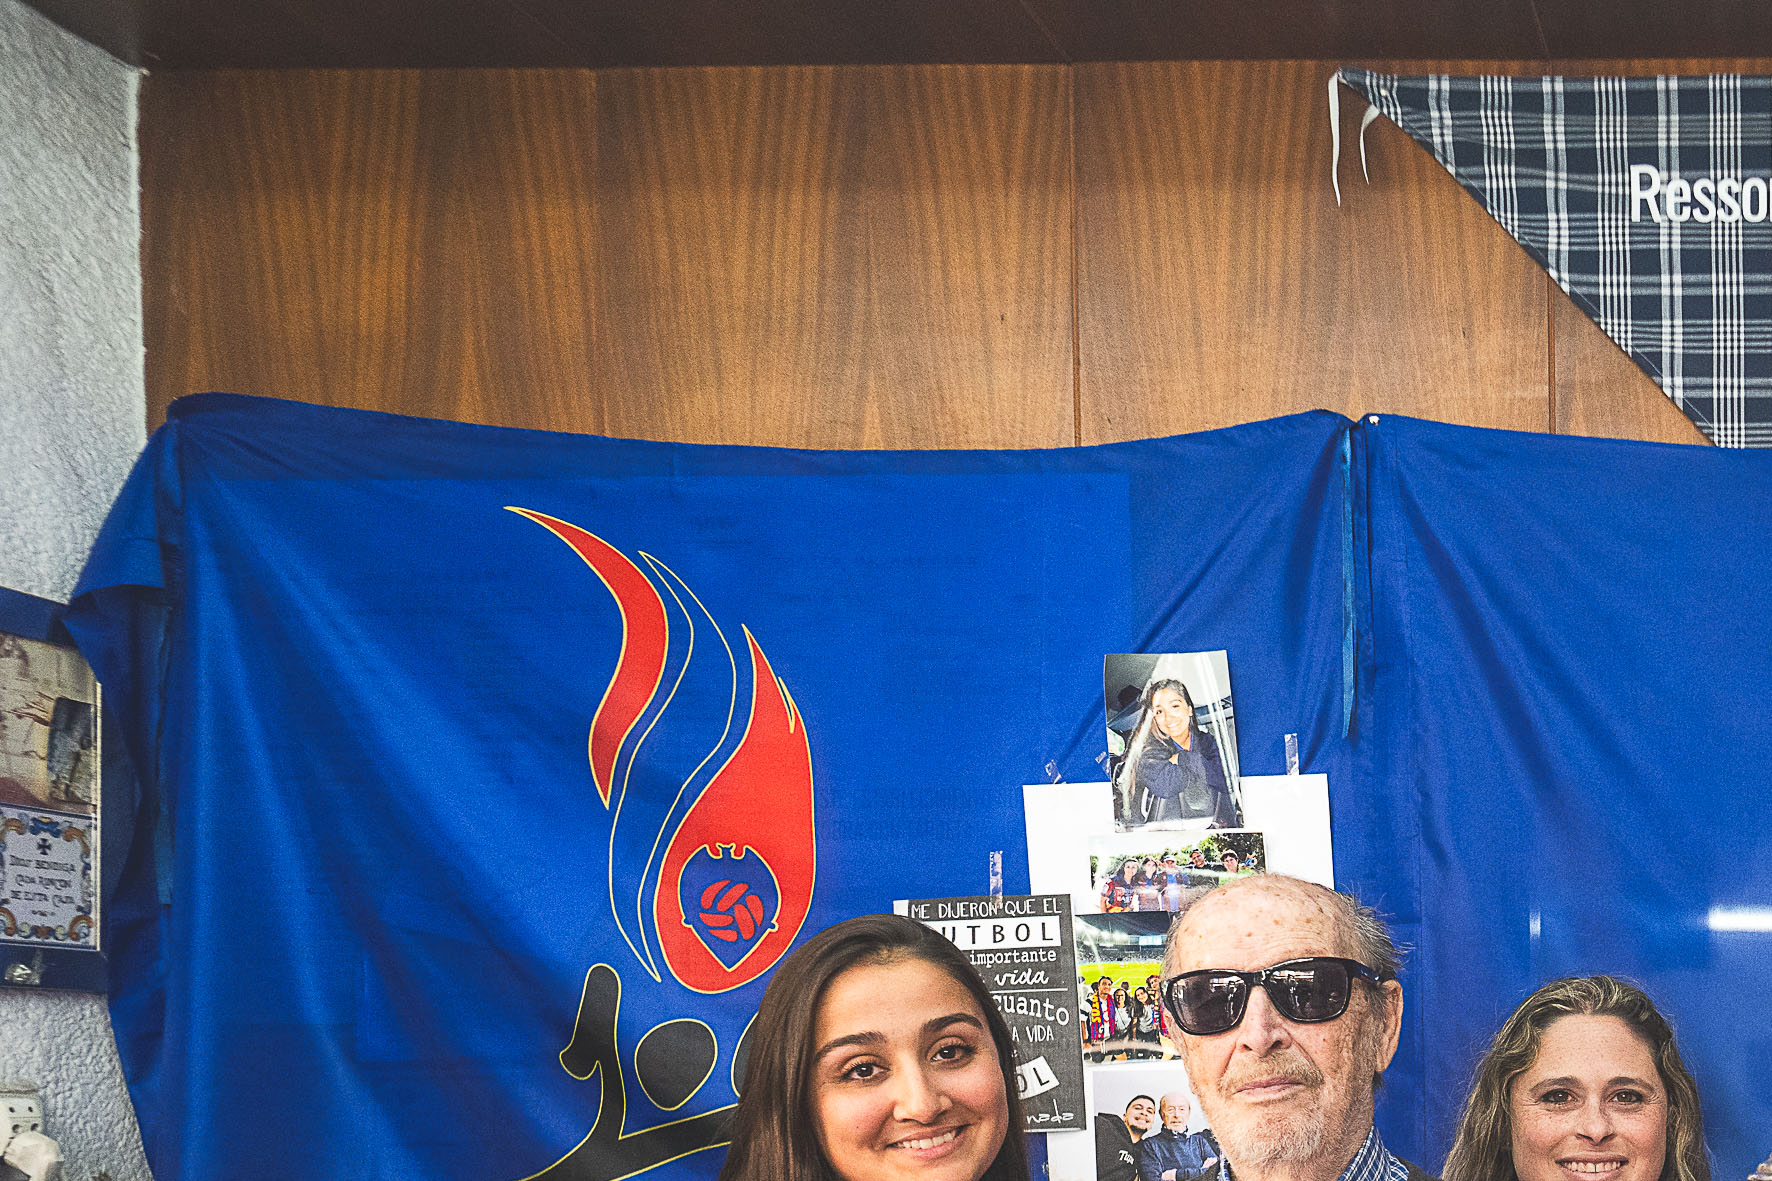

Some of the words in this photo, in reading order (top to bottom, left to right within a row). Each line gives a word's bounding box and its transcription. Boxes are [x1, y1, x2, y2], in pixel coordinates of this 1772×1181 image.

[911, 903, 930, 919] ME
[938, 901, 998, 919] DIJERON
[1004, 899, 1036, 917] QUE
[1043, 897, 1062, 914] EL
[969, 949, 1057, 966] importante
[994, 967, 1050, 987] vida
[1025, 1024, 1055, 1044] VIDA
